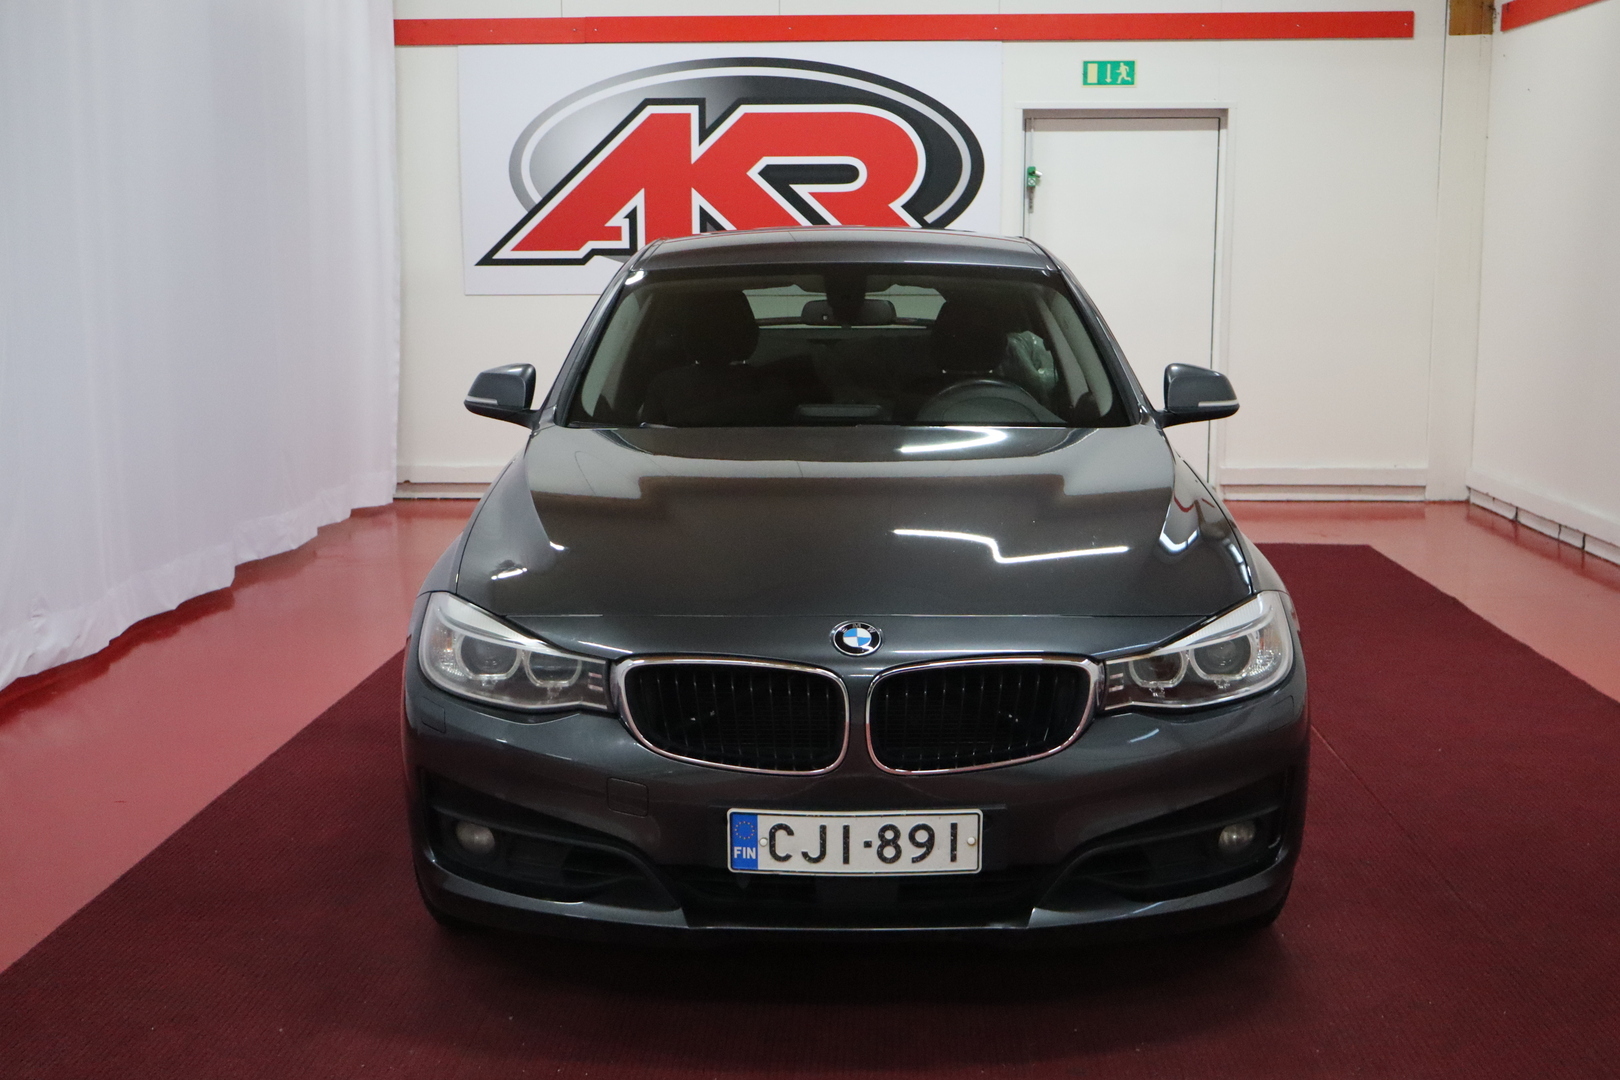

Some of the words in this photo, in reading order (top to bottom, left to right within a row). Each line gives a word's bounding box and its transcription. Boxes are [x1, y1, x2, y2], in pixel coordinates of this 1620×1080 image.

[476, 98, 926, 265] AKR
[734, 846, 756, 859] FIN
[768, 822, 958, 864] CJI-891
